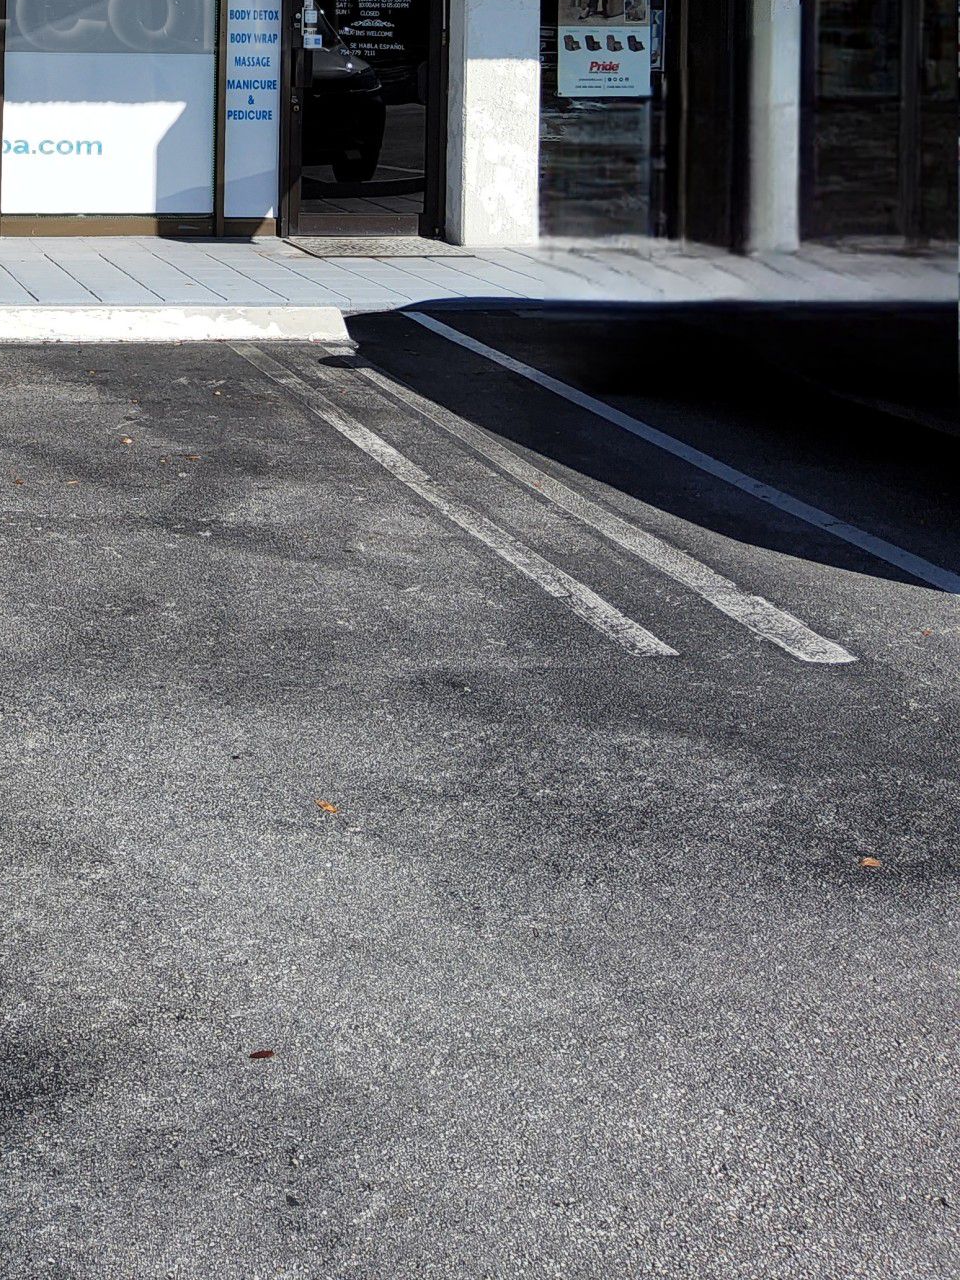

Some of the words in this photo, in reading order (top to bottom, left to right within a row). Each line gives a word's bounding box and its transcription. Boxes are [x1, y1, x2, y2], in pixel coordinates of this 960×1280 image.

[229, 10, 251, 21] BODY
[253, 10, 280, 21] DETOX
[230, 33, 252, 44] BODY
[254, 33, 278, 44] WRAP
[234, 56, 271, 67] MASSAGE
[589, 61, 620, 72] Pride
[227, 79, 277, 90] MANICURE
[247, 94, 255, 105] &
[227, 109, 273, 121] PEDICURE
